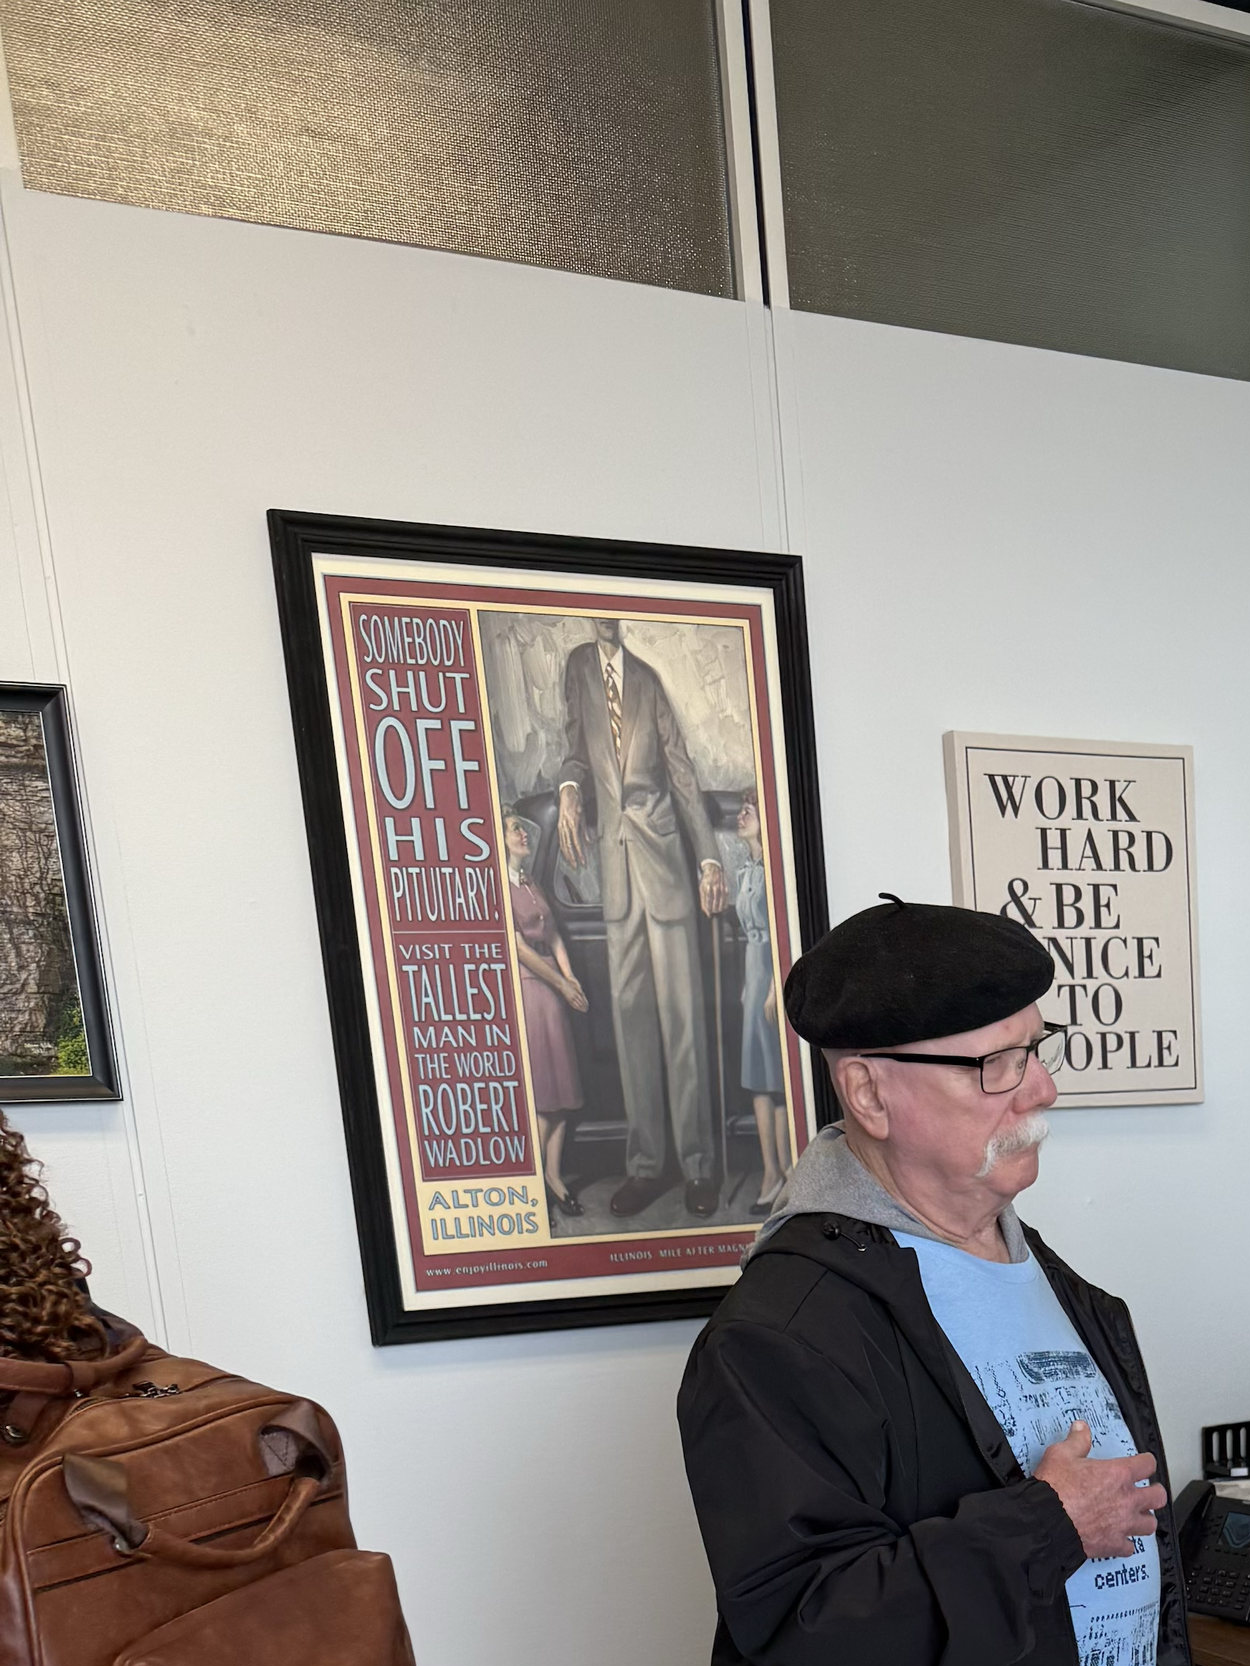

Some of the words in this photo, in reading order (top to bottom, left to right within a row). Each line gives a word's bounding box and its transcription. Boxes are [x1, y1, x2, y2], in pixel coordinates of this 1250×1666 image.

[359, 614, 465, 667] SOMEBODY
[365, 668, 470, 713] SHUT
[374, 716, 480, 810] OFF
[983, 773, 1140, 823] WORK
[384, 816, 491, 862] HIS
[1035, 827, 1174, 873] HARD
[390, 866, 500, 922] PITUITARY!
[1000, 877, 1043, 930] &
[1049, 882, 1121, 930] BE
[399, 944, 453, 960] VISIT
[460, 943, 503, 959] THE
[1042, 936, 1163, 981] NICE
[401, 963, 507, 1022] TALLEST
[1057, 983, 1123, 1027] TO
[413, 1025, 476, 1049] MAN
[485, 1024, 511, 1046] IN
[1065, 1029, 1181, 1071] OPLE
[414, 1053, 451, 1080] THE
[454, 1050, 516, 1079] WORLD
[418, 1081, 520, 1136] ROBERT
[424, 1135, 527, 1168] WADLOW
[428, 1185, 539, 1211] ALTON,
[431, 1212, 539, 1241] ILLINOIS
[426, 1259, 549, 1277] www.enjoyillinois.com
[610, 1250, 653, 1263] ILLINOIS
[659, 1246, 682, 1258] MILE
[686, 1245, 716, 1257] AFTER
[1095, 1563, 1150, 1590] centers.
